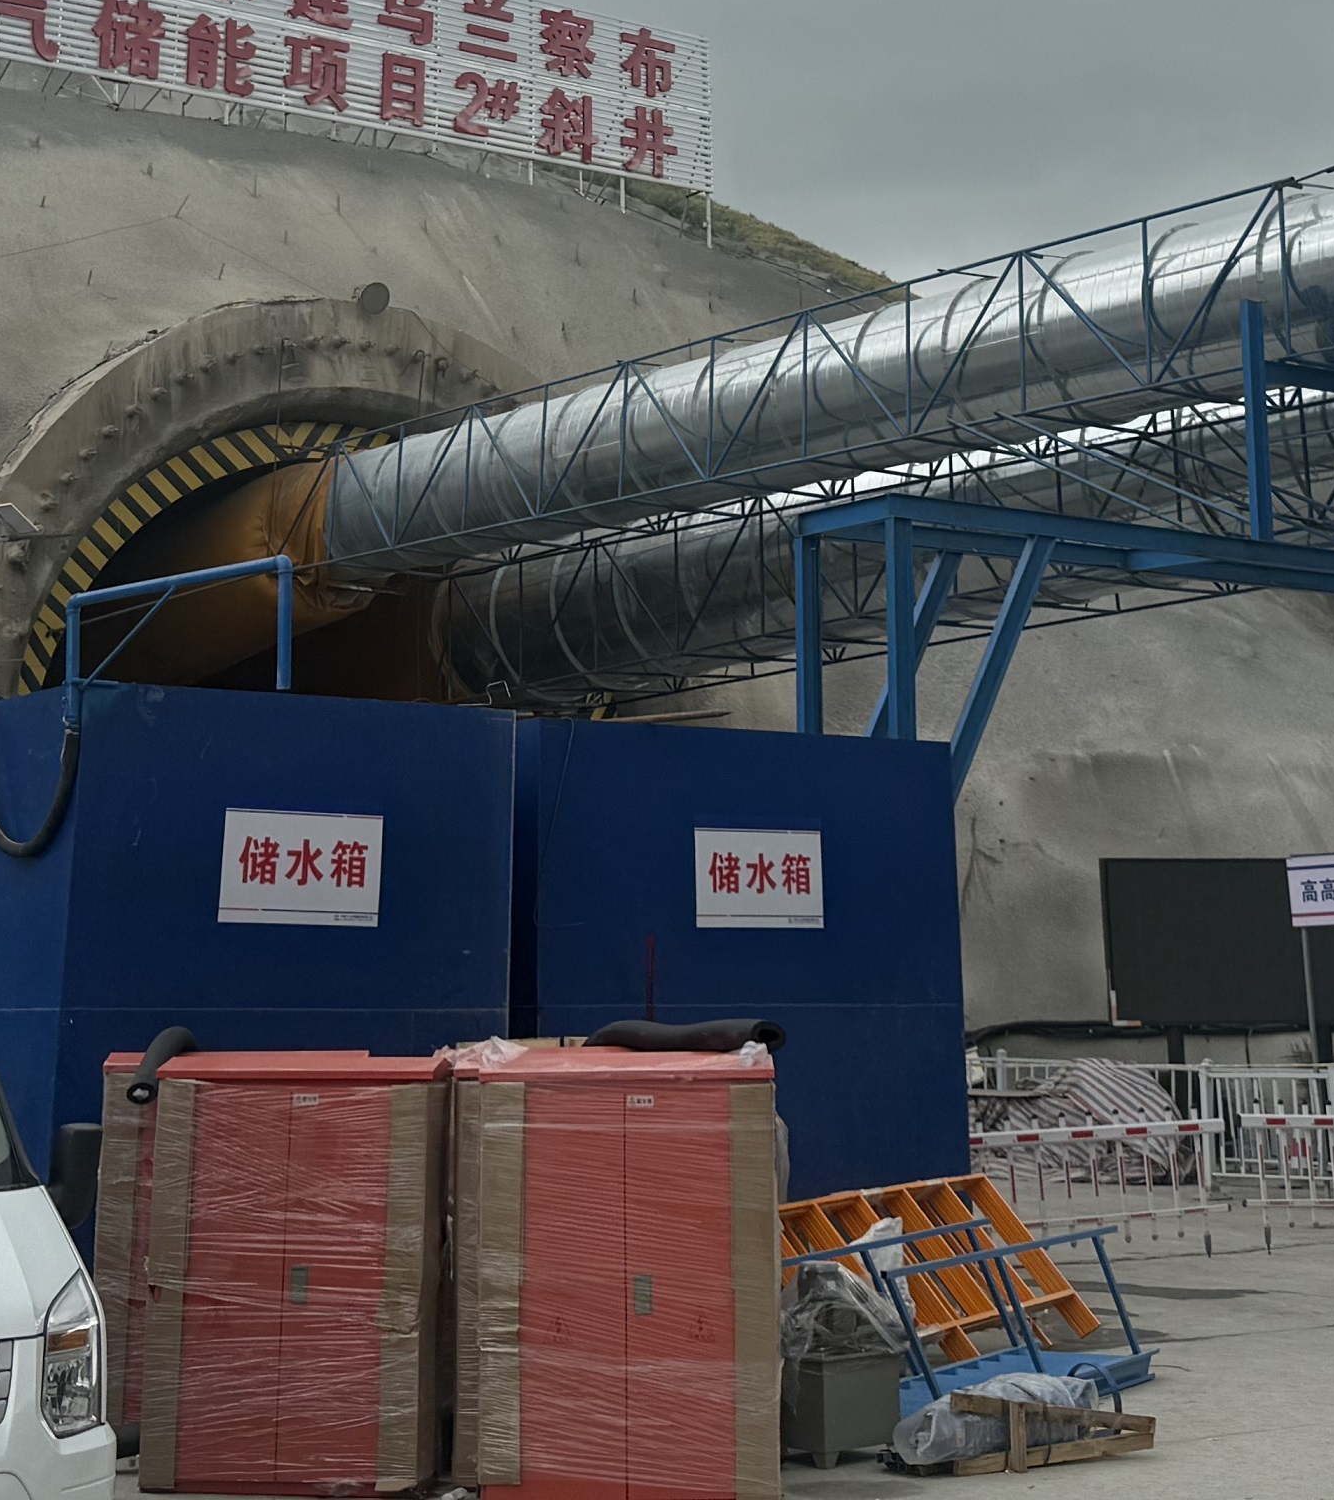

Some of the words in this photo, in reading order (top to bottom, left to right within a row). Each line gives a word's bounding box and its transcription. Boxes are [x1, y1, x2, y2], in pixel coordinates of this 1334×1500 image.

[238, 835, 369, 888] 储水箱
[708, 851, 811, 895] 储水箱
